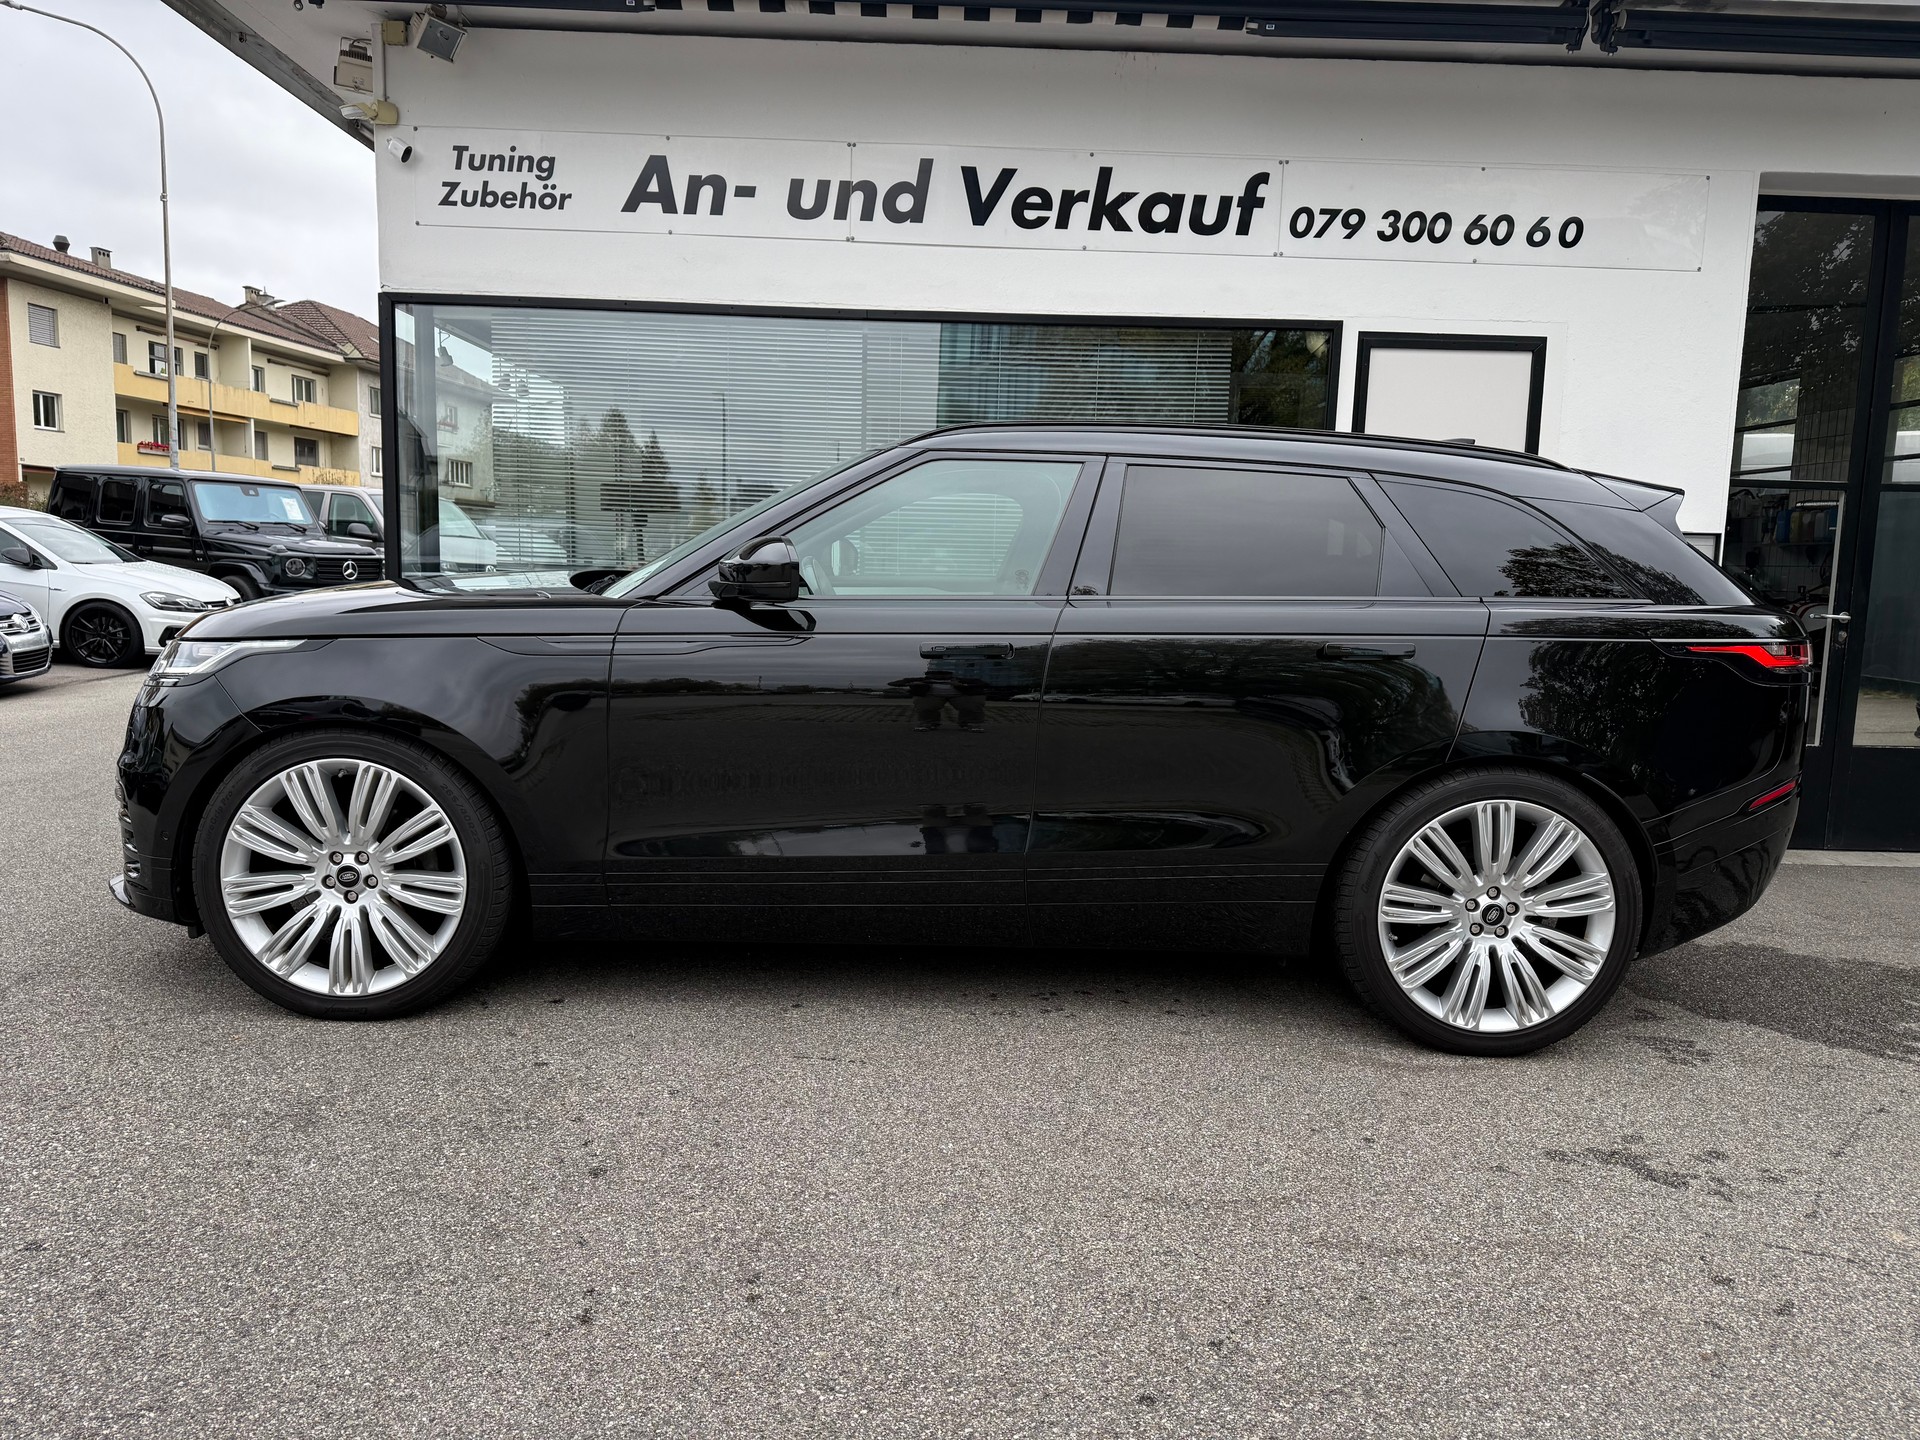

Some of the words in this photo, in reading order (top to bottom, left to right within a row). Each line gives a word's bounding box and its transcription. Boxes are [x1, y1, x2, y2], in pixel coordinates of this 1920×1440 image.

[452, 145, 556, 182] Tuning
[437, 181, 573, 211] Zubehör
[620, 154, 757, 216] An-
[786, 157, 934, 224] und
[960, 165, 1271, 237] Verkauf
[1289, 206, 1366, 240] 079
[1376, 209, 1453, 245] 300
[1463, 213, 1515, 247] 60
